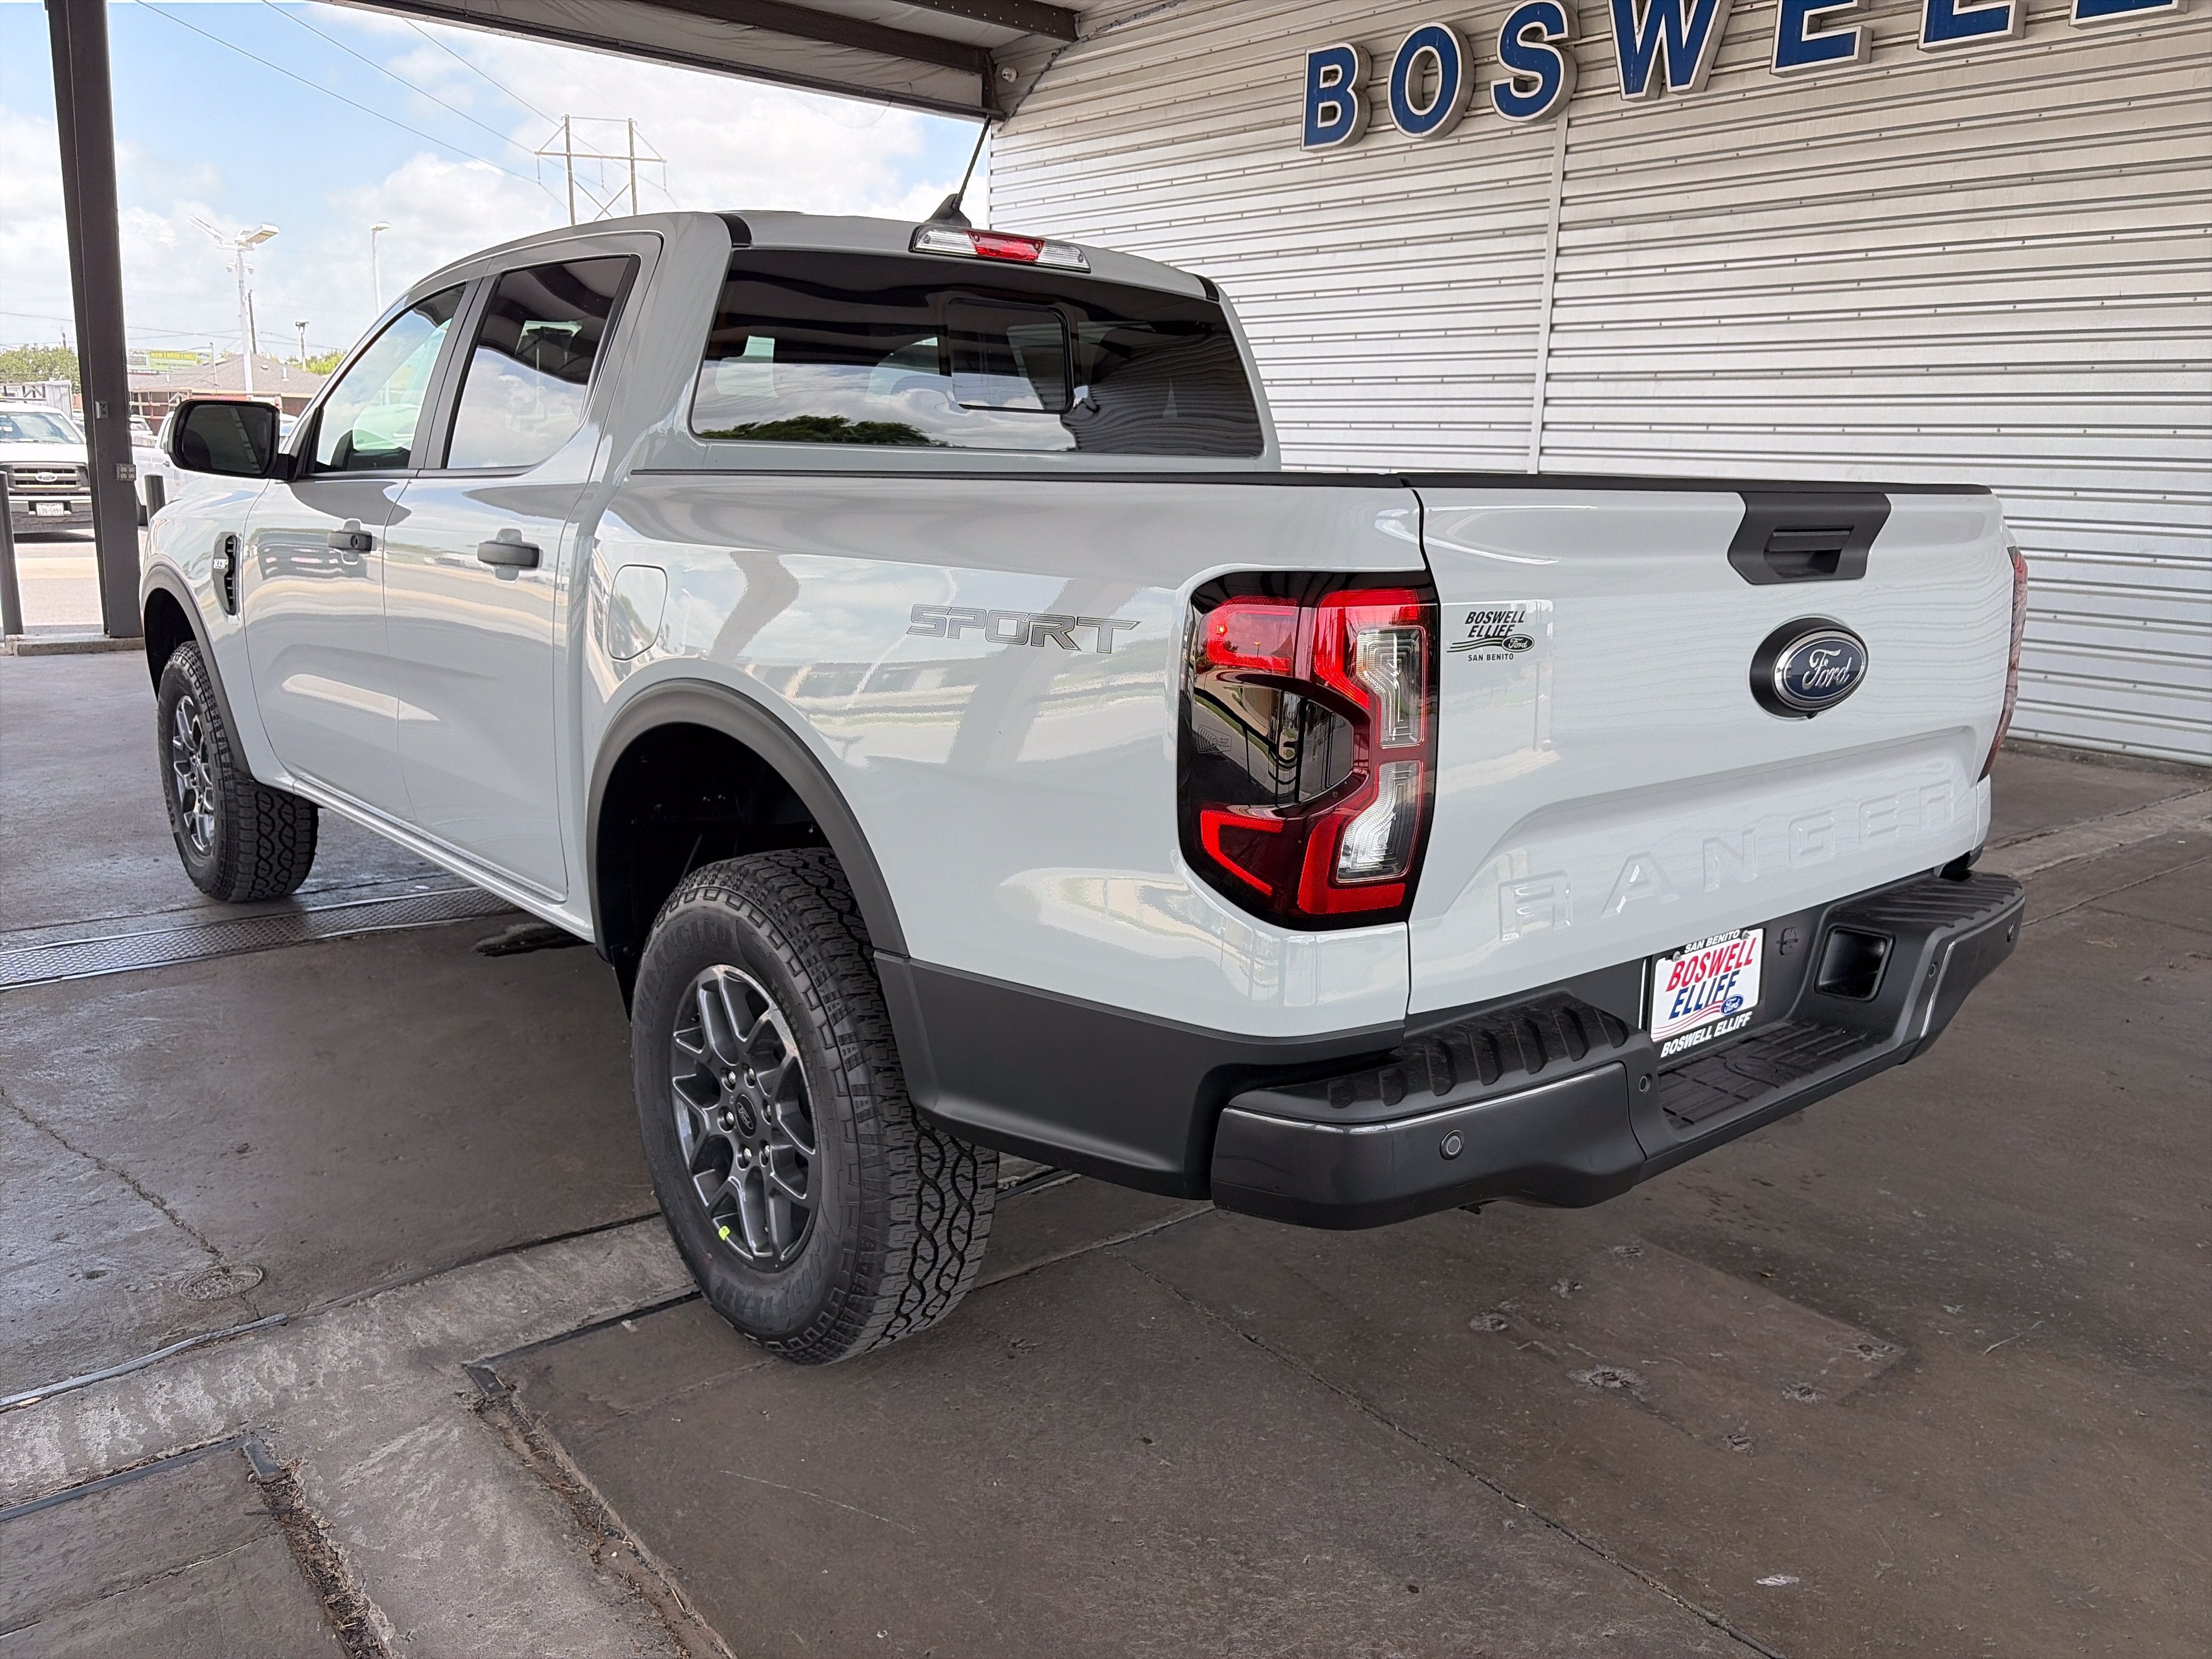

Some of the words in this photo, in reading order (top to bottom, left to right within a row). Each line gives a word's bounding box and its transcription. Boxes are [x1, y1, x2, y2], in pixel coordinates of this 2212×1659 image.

[1301, 0, 2188, 152] BOSWE
[906, 604, 1141, 654] SPORT
[1464, 611, 1526, 624] BOSWELL
[1468, 624, 1516, 638] ELLIFF
[1508, 637, 1528, 650] Ford
[1802, 648, 1852, 690] Ford
[1498, 779, 1954, 942] RANGER
[1684, 941, 1704, 953] SAN
[1706, 929, 1740, 947] BENITO
[1665, 936, 1757, 992] BOSWELL
[1668, 969, 1741, 1020] ELLIFF
[1724, 997, 1741, 1014] Ford
[1661, 1025, 1713, 1058] BOSWELL
[1713, 1011, 1753, 1037] ELLIFF
